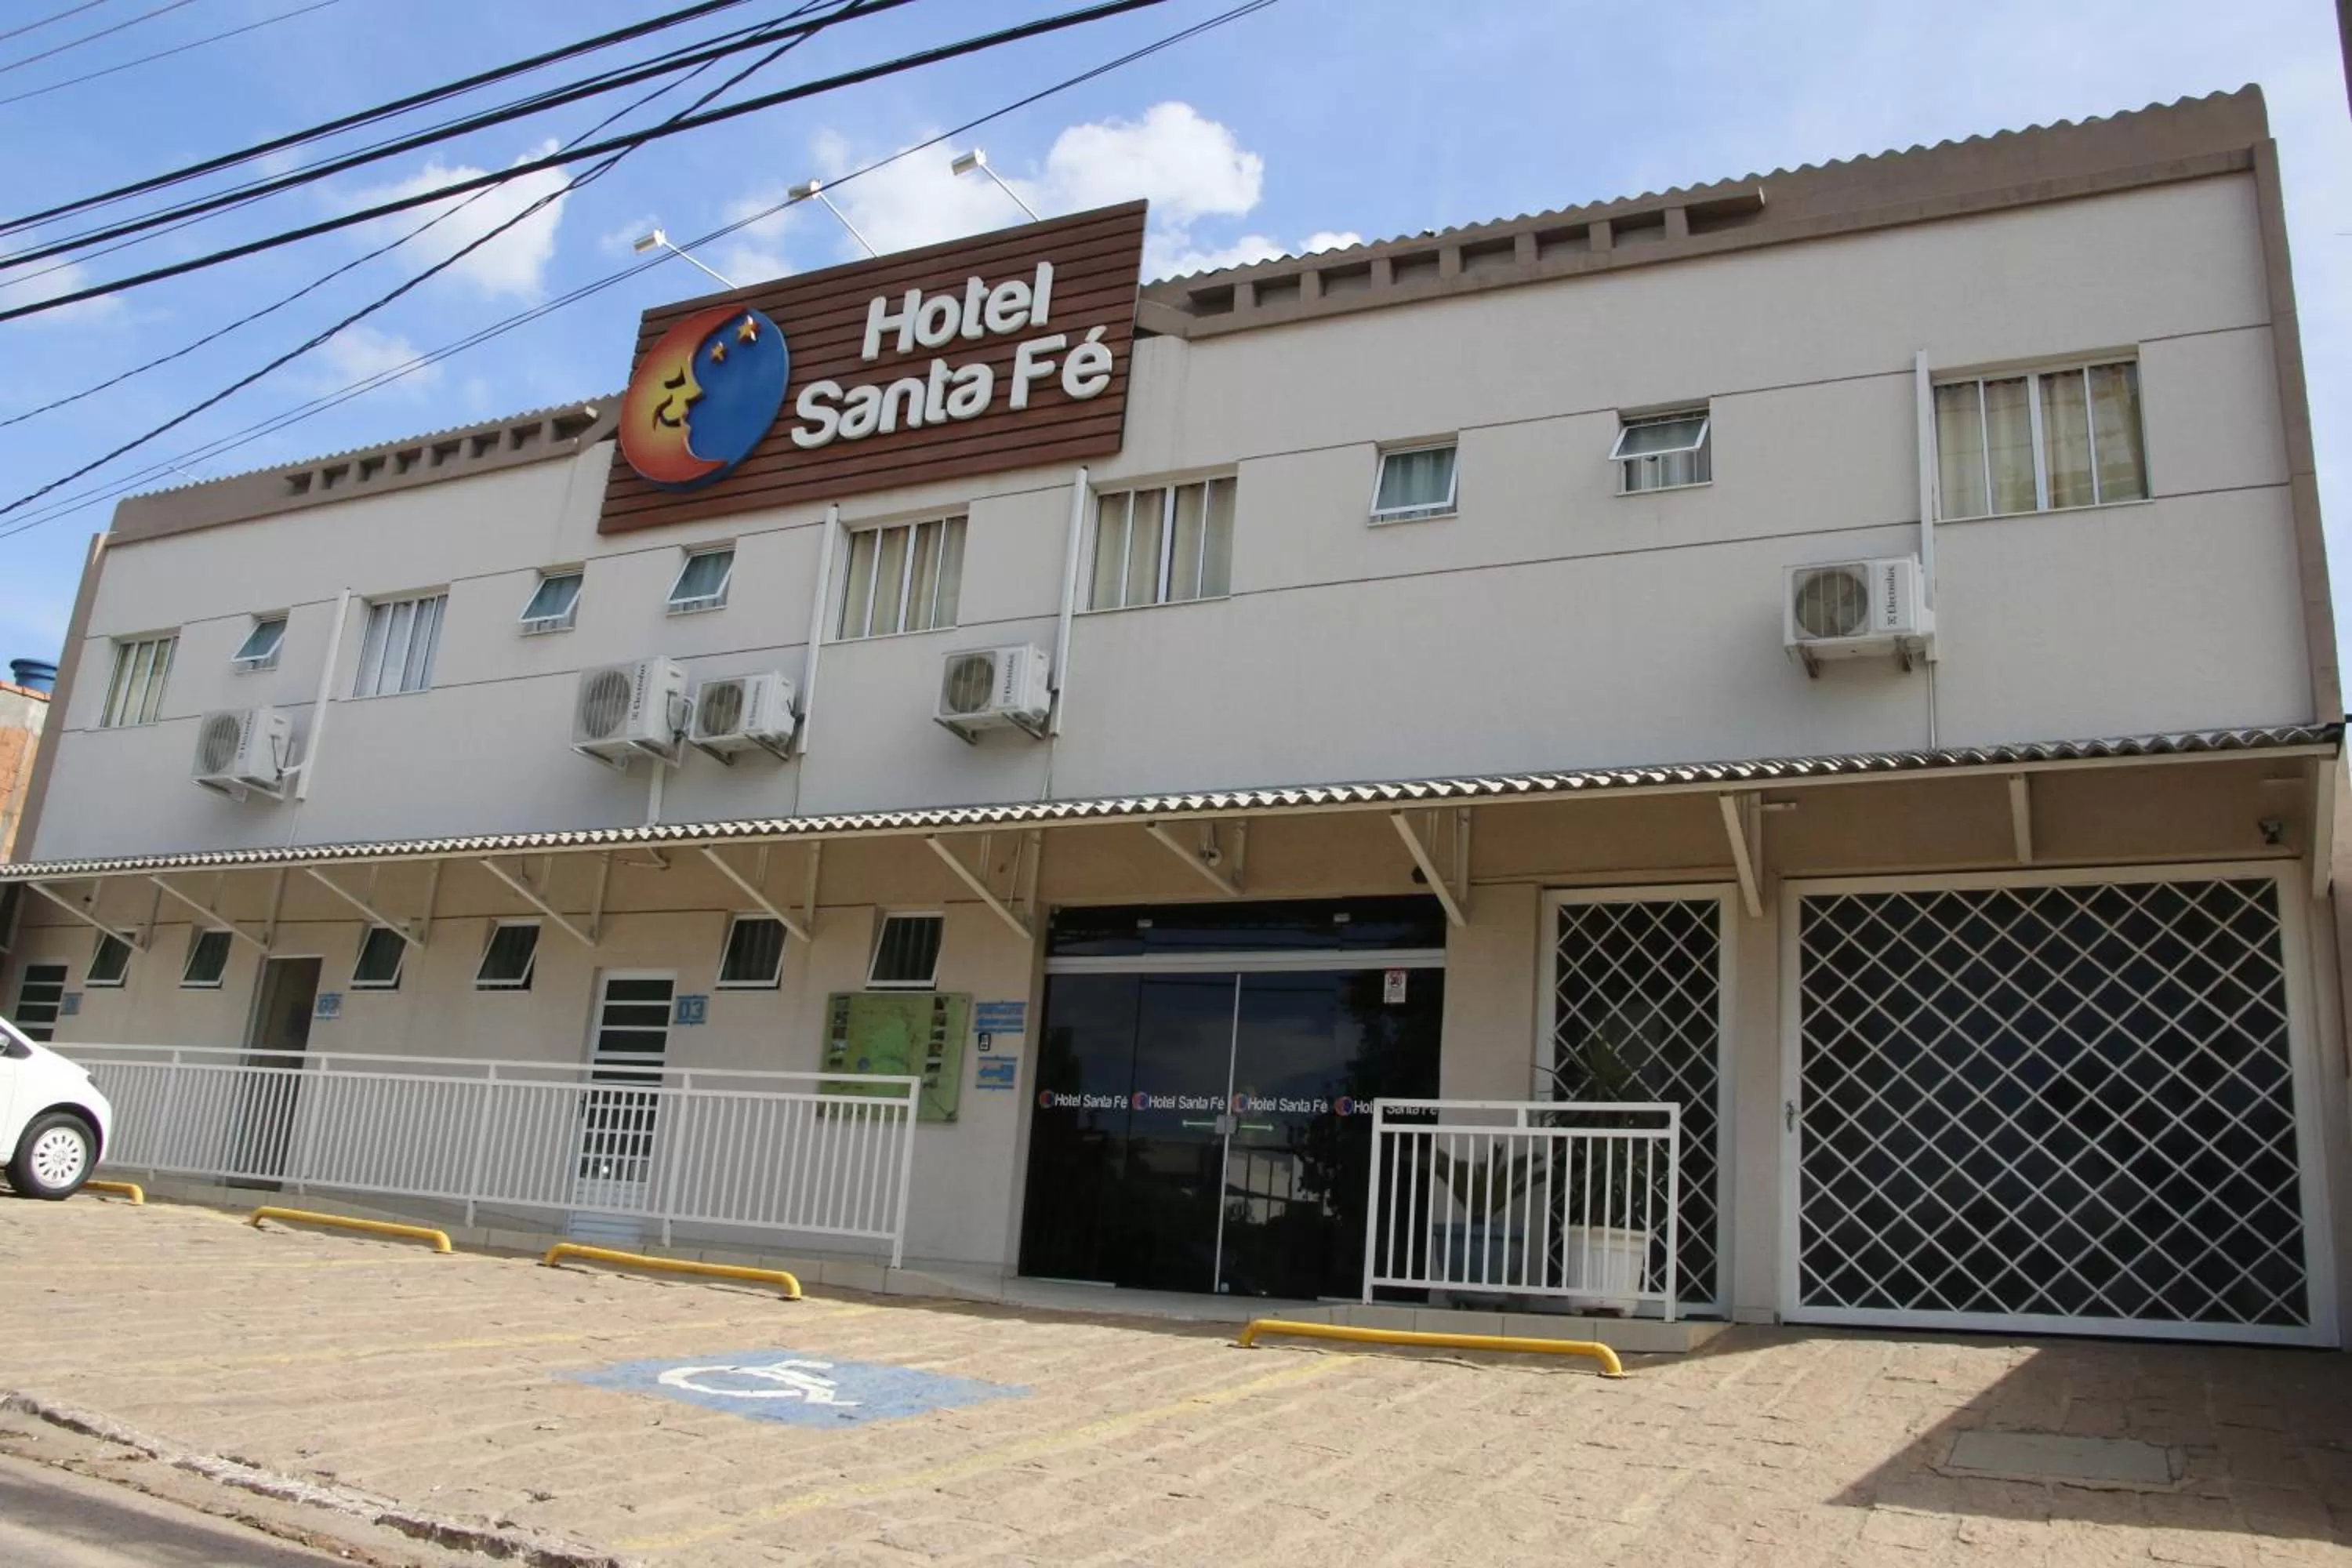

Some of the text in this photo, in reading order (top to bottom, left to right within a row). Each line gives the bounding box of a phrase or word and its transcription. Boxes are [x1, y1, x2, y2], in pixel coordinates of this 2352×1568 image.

[862, 261, 1054, 361] Hotel
[791, 325, 1113, 449] Santa Fé
[677, 1000, 703, 1019] 03
[1054, 1094, 1081, 1107] Hotel
[1083, 1094, 1112, 1108] Santa
[1149, 1095, 1176, 1109] Hotel
[1178, 1095, 1208, 1109] Santa
[1247, 1097, 1277, 1111] Hotel
[1279, 1098, 1311, 1112] Santa
[1354, 1100, 1374, 1114] Hot
